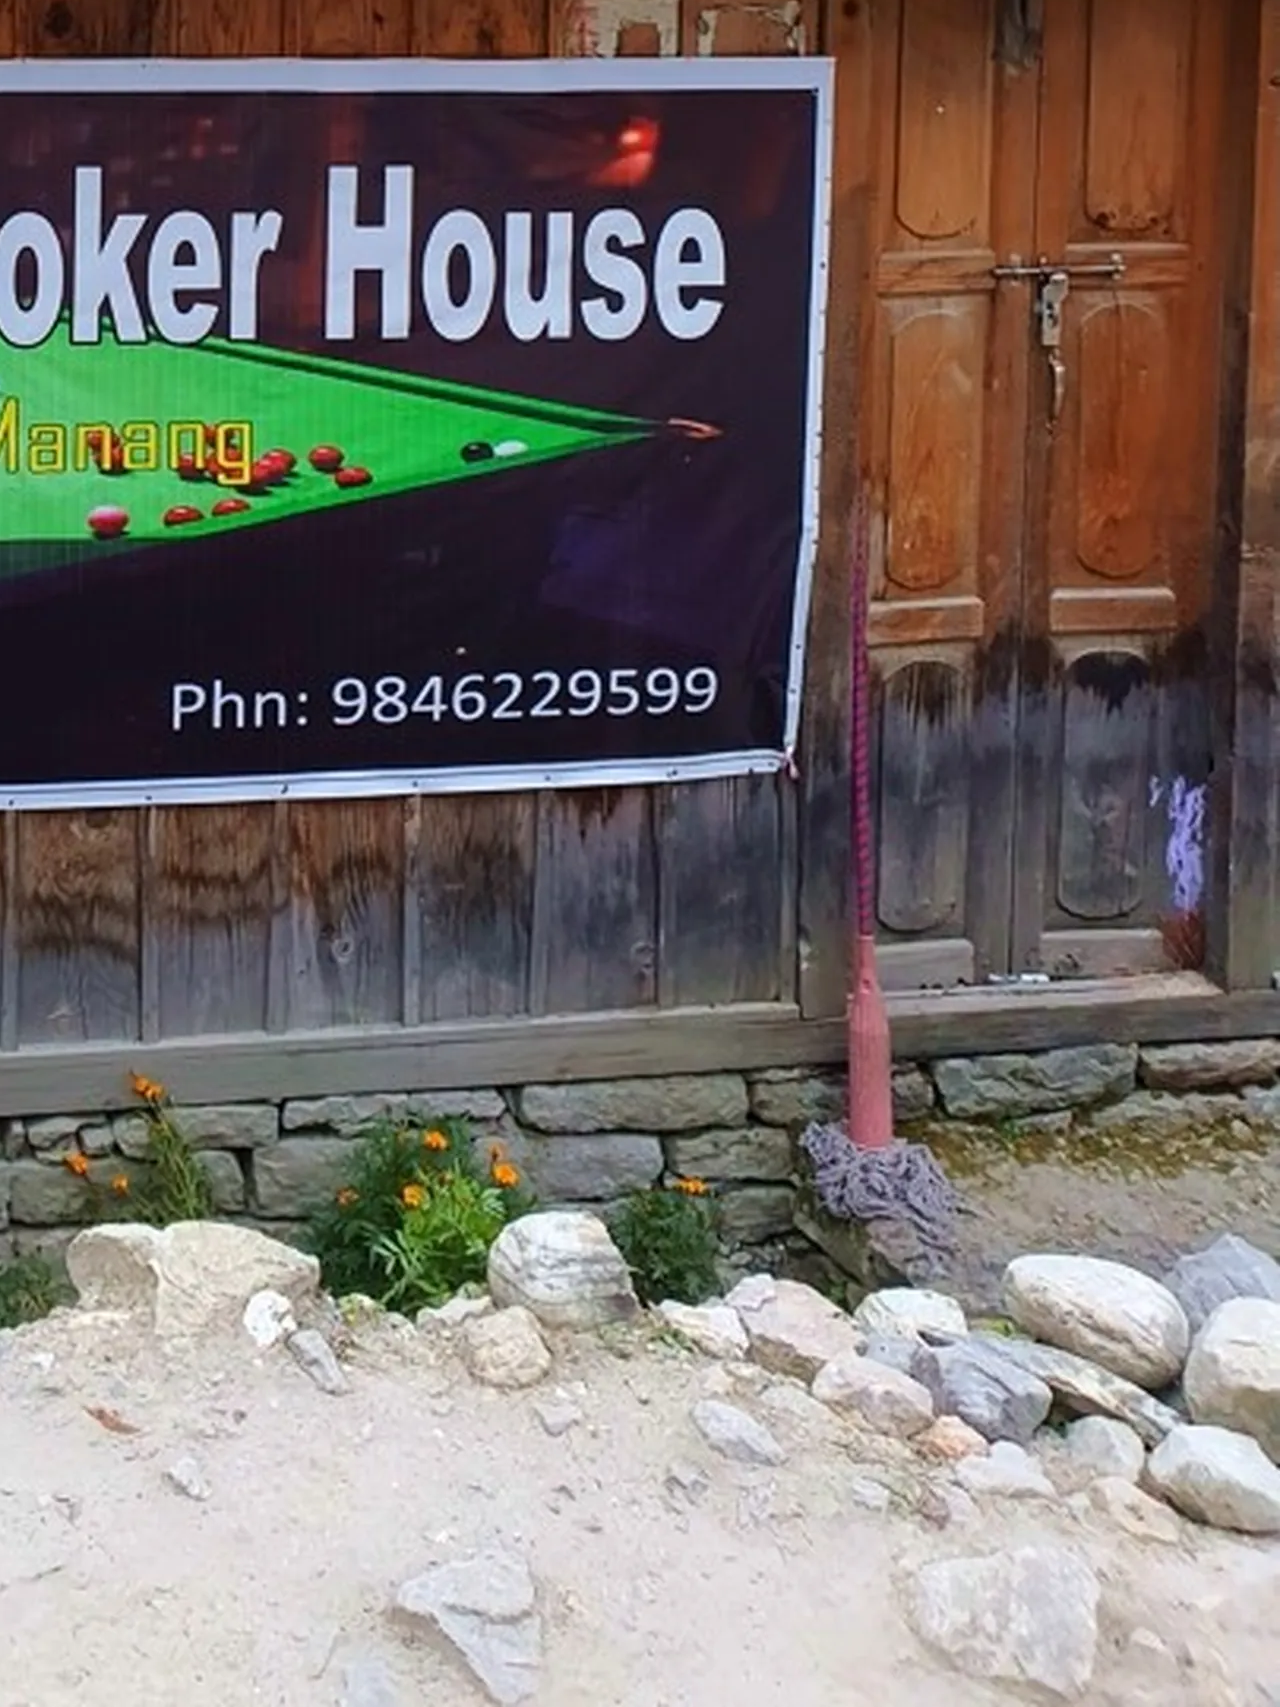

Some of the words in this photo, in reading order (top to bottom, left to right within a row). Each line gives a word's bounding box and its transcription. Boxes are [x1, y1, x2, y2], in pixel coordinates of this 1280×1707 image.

[324, 164, 726, 341] House
[171, 679, 309, 731] Phn:
[331, 665, 719, 726] 9846229599
